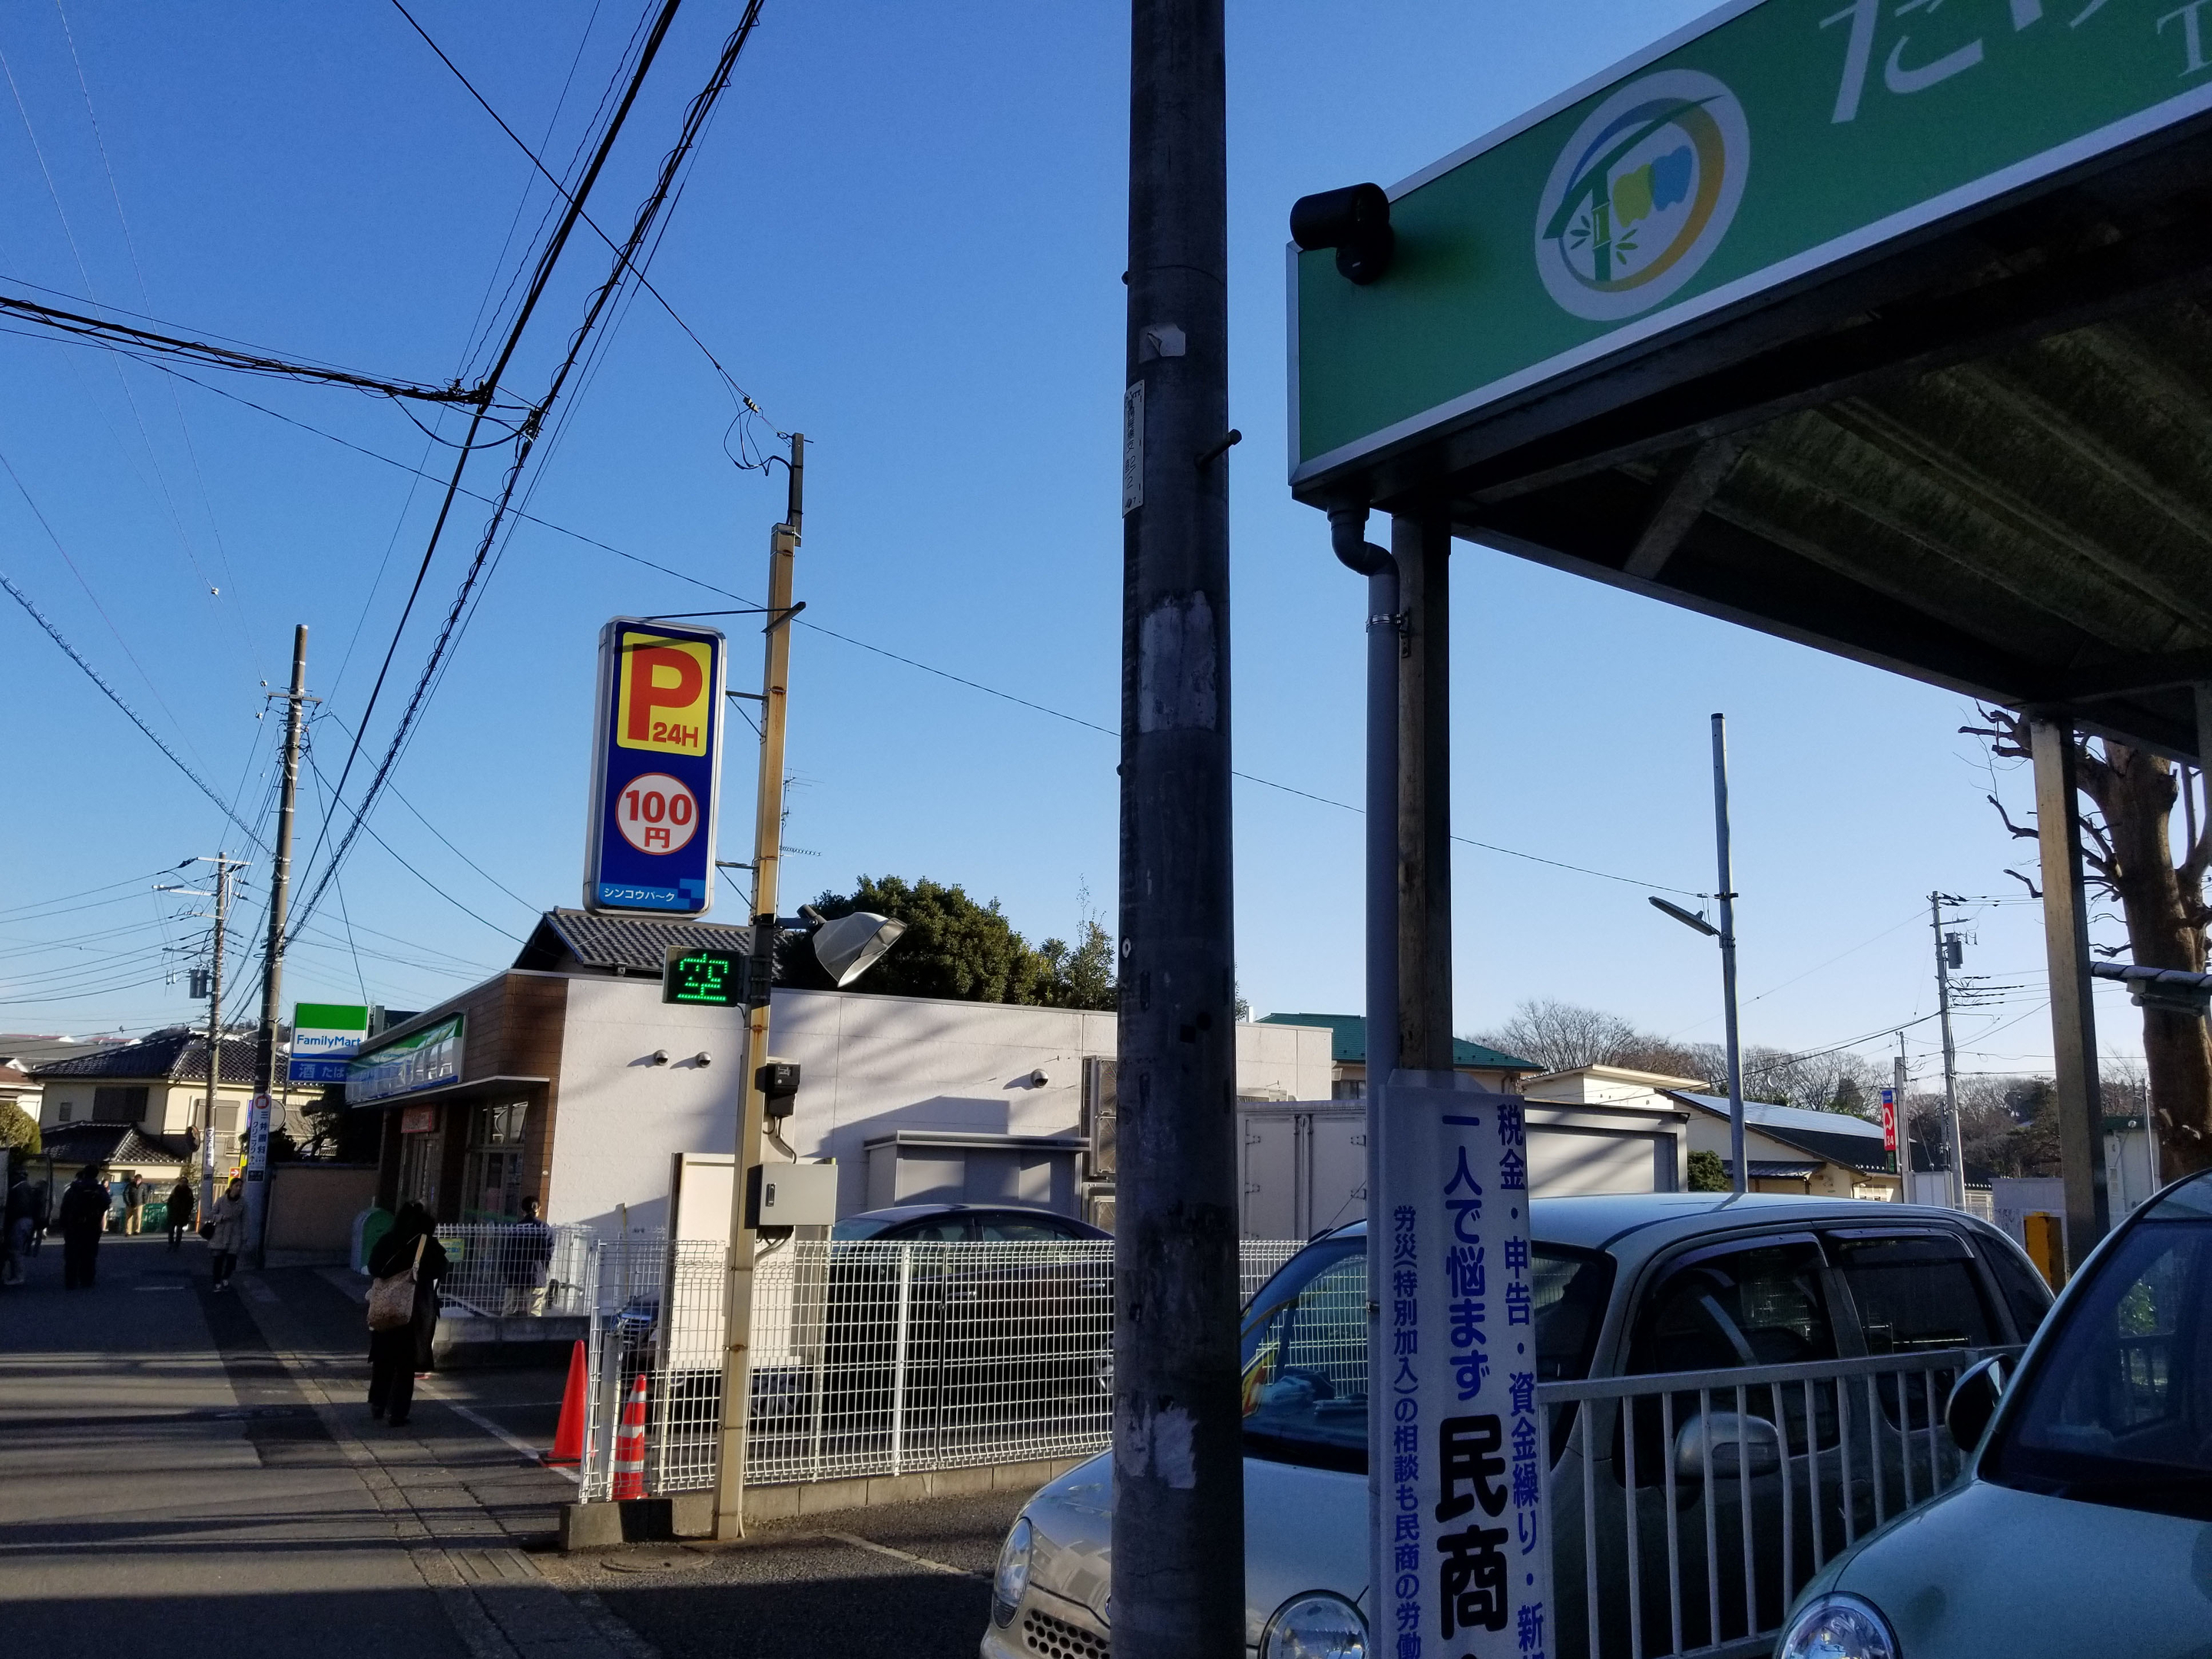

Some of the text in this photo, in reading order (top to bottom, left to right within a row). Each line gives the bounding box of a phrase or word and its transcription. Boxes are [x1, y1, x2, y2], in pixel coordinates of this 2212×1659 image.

[627, 642, 702, 742] P
[652, 721, 699, 749] 24H
[624, 789, 692, 827] 100
[644, 826, 671, 849] 円
[677, 953, 730, 1002] 空
[296, 1034, 361, 1049] FamilyMart
[298, 1062, 346, 1080] 酒 たば
[1886, 1135, 1895, 1146] 24
[1496, 1103, 1545, 1659] 税金・申告・資金繰り・新
[1435, 1413, 1509, 1659] 民商
